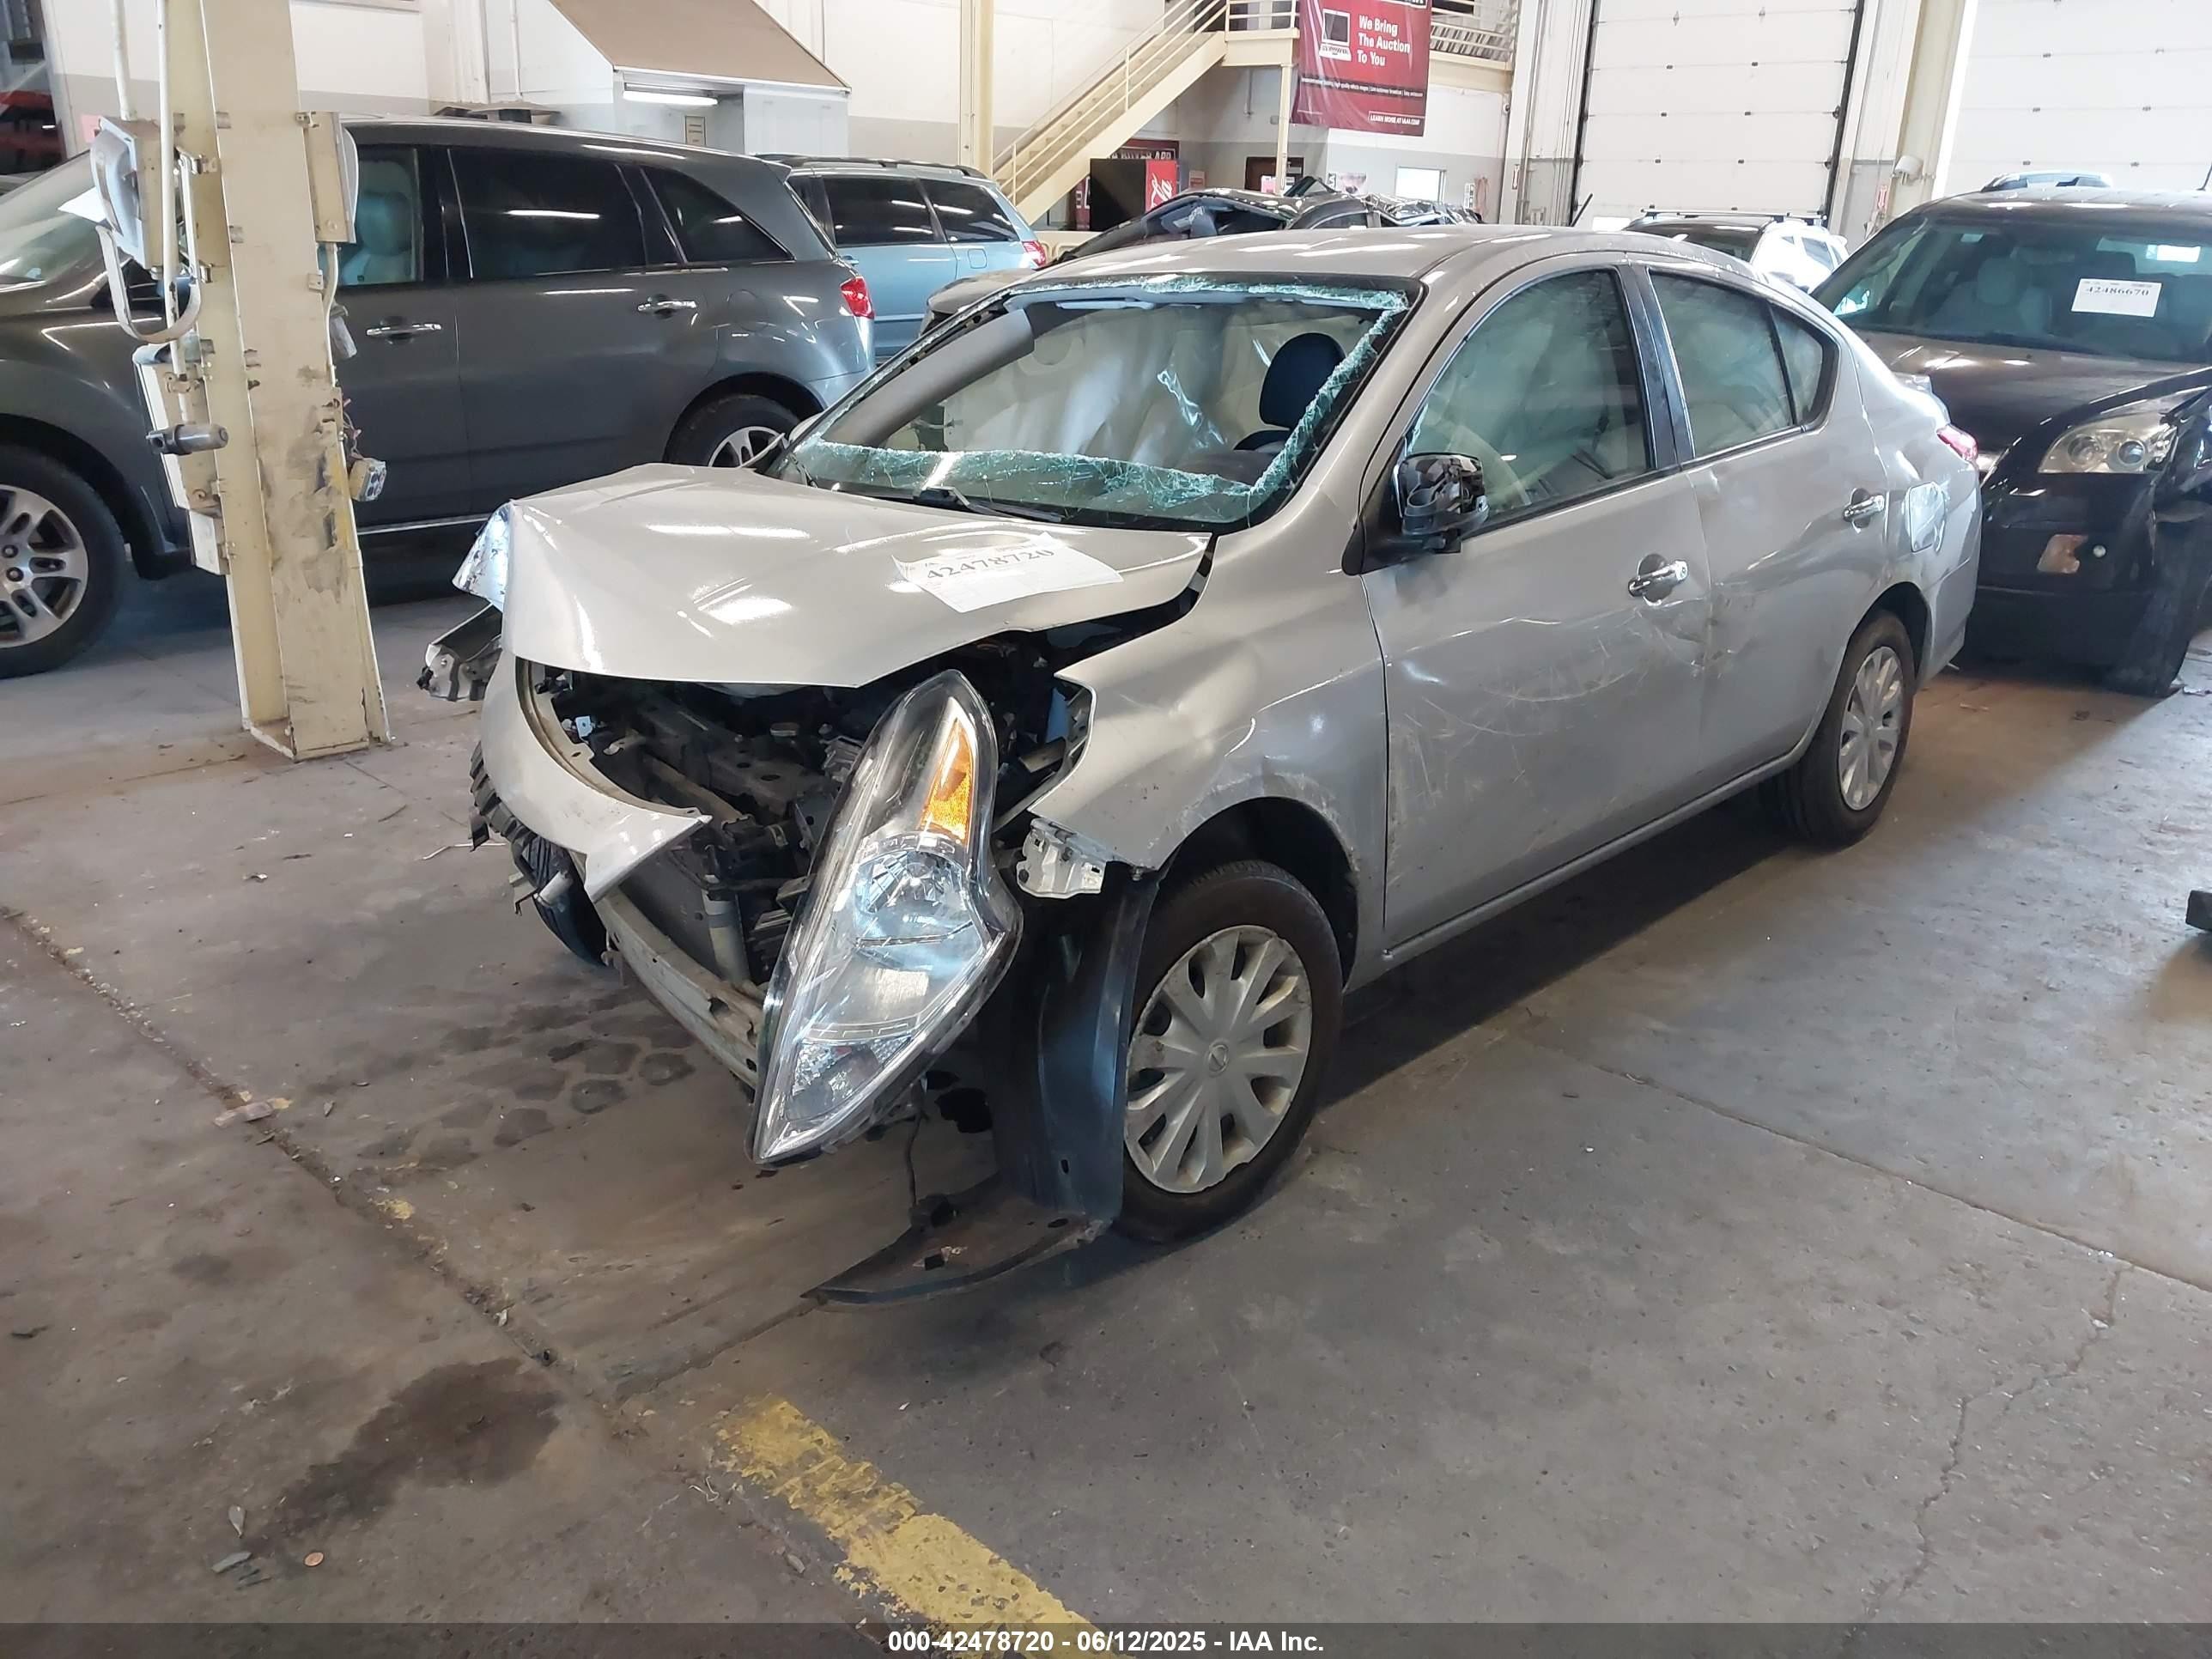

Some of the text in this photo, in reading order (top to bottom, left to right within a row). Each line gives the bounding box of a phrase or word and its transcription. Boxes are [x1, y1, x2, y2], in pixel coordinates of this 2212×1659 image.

[1358, 15, 1398, 37] We Bring
[1358, 33, 1411, 54] The Auction
[1357, 50, 1386, 66] To You
[2086, 286, 2149, 296] 42486670
[927, 550, 1054, 579] 42478720
